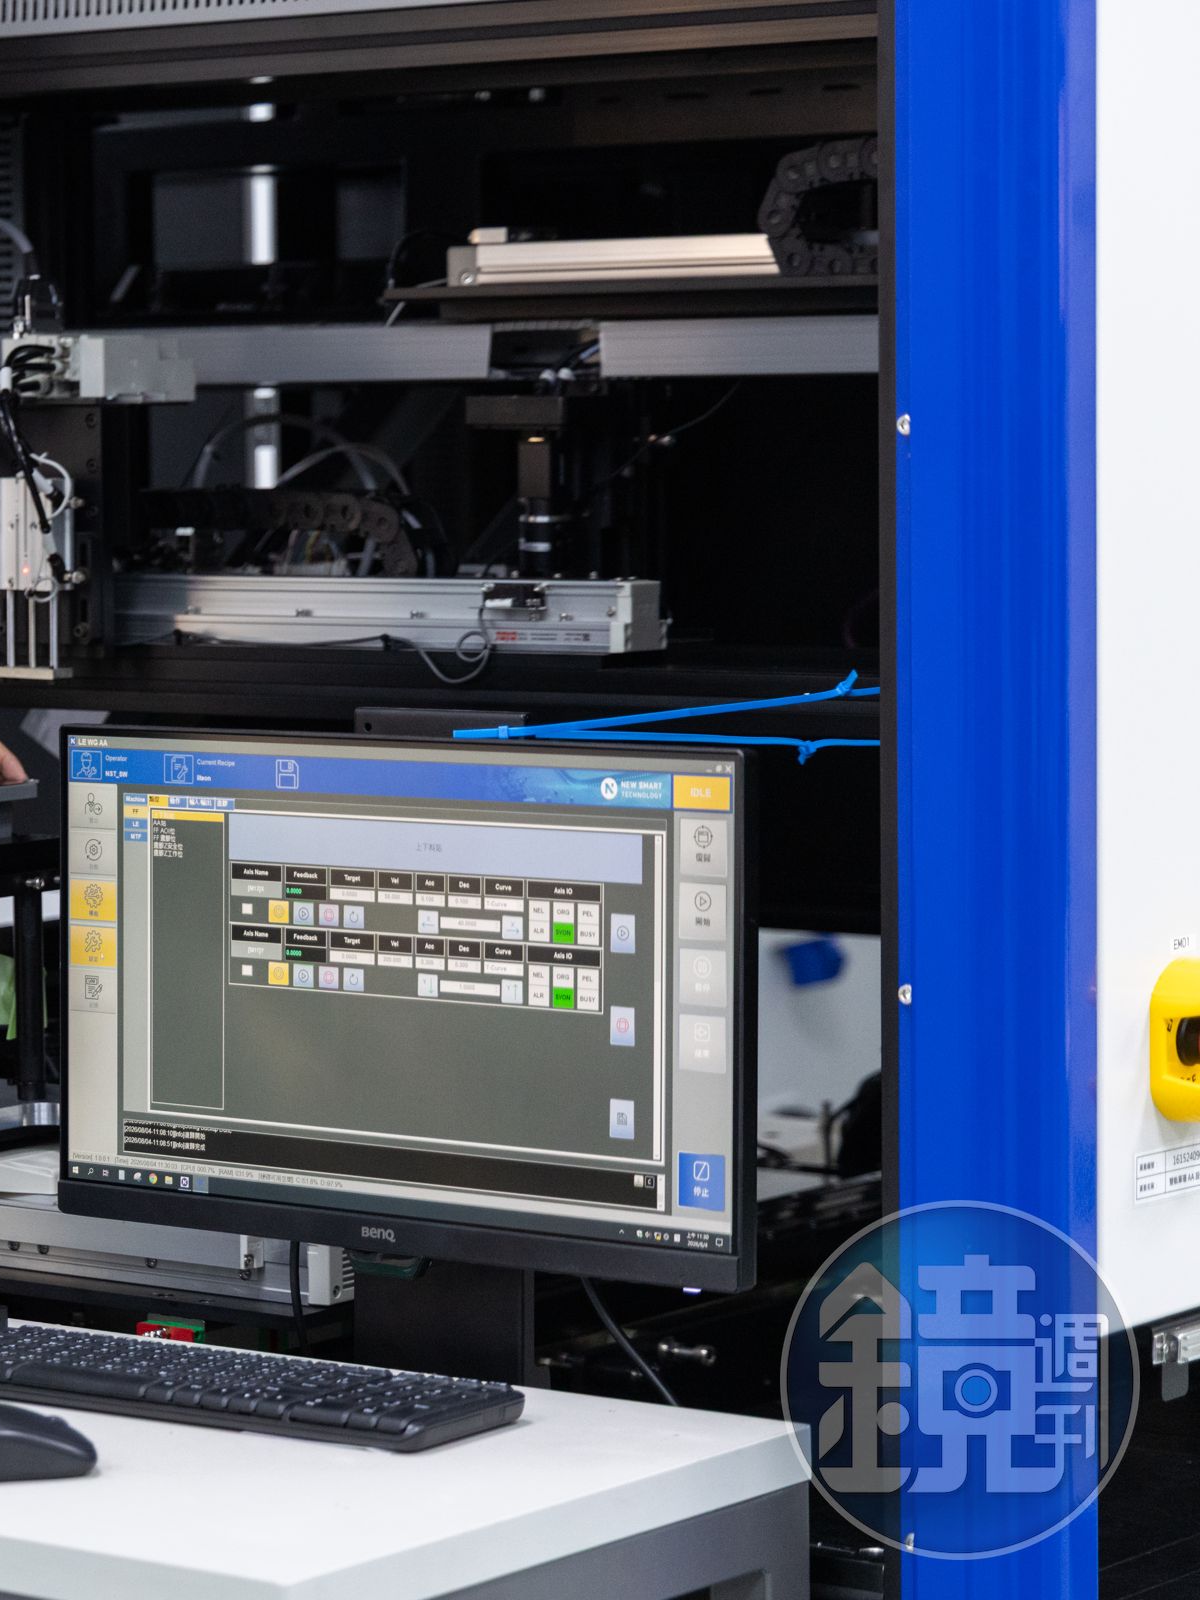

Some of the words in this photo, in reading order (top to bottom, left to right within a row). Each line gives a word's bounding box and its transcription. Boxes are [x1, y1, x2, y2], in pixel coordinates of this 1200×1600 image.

[105, 754, 128, 762] Operator
[196, 758, 217, 766] Current
[217, 759, 236, 768] Recipe
[621, 781, 637, 790] NEW
[638, 781, 663, 791] SMART
[621, 791, 663, 800] TECHNOLOGY
[690, 787, 712, 798] IDLE
[254, 869, 269, 877] Name
[293, 871, 318, 879] Feedback
[343, 874, 361, 883] Target
[495, 883, 512, 892] Curve
[553, 887, 565, 895] Axis
[556, 908, 570, 916] ORG
[293, 933, 318, 941] Feedback
[580, 930, 596, 938] BUSY
[343, 936, 361, 946] Target
[495, 947, 512, 956] Curve
[553, 951, 565, 959] Axis
[580, 995, 596, 1003] BUSY
[693, 1186, 710, 1198] 停止
[361, 1226, 396, 1243] BenQ
